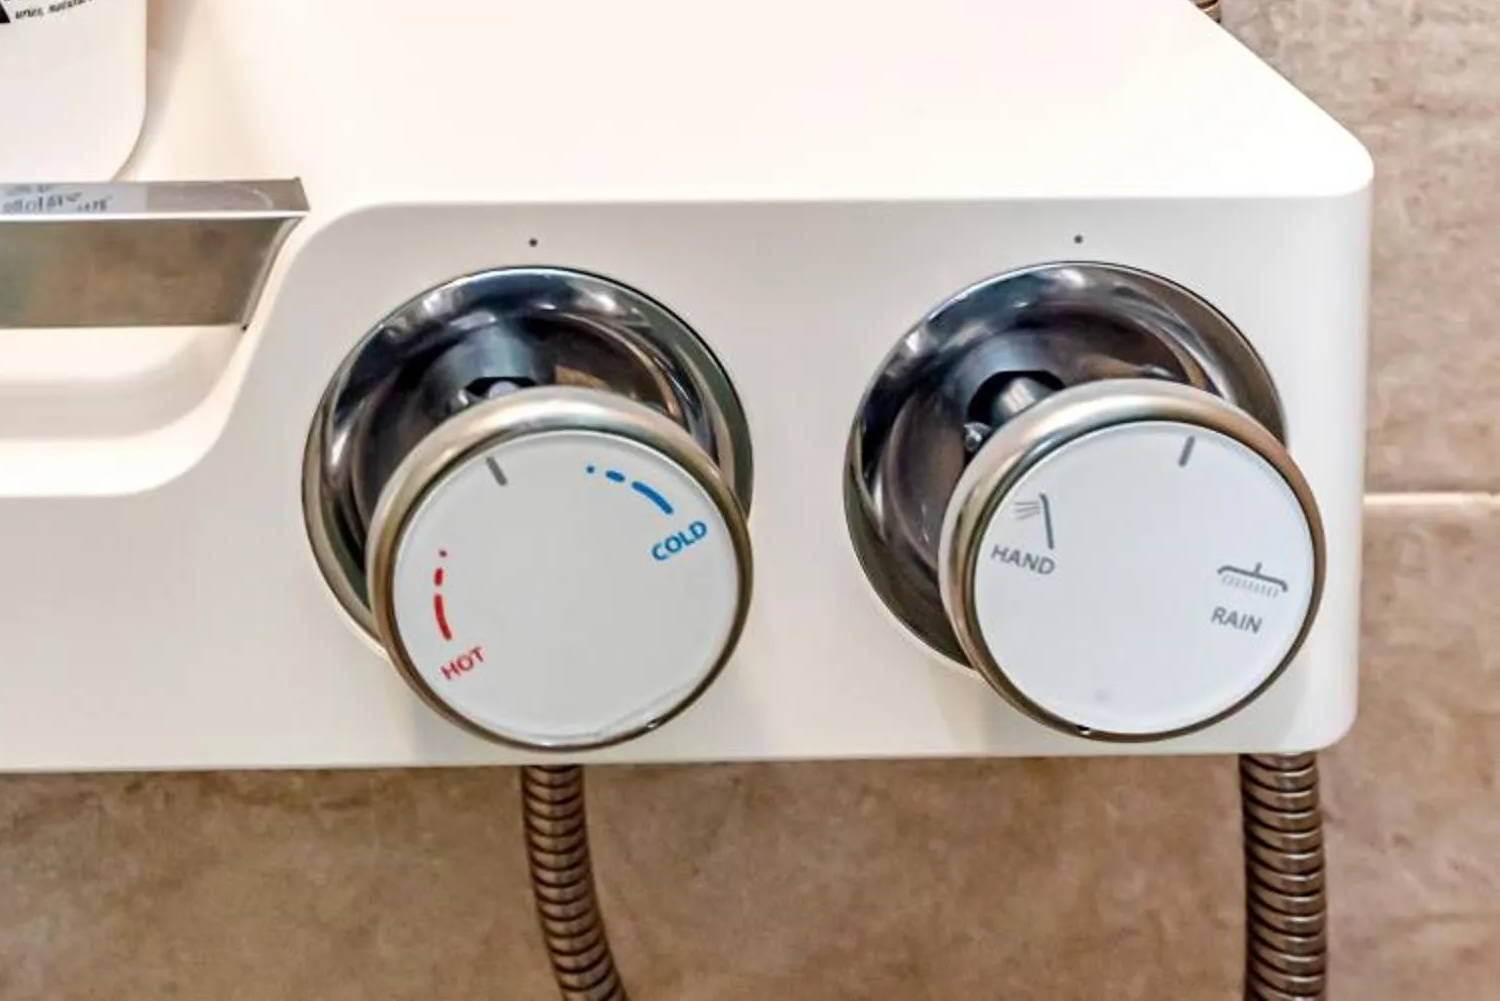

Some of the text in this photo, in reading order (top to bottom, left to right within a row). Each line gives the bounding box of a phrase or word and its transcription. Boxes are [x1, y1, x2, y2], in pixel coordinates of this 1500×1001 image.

[651, 520, 708, 562] COLD
[990, 544, 1056, 576] HAND
[1210, 607, 1263, 635] RAIN
[439, 646, 486, 681] HOT
